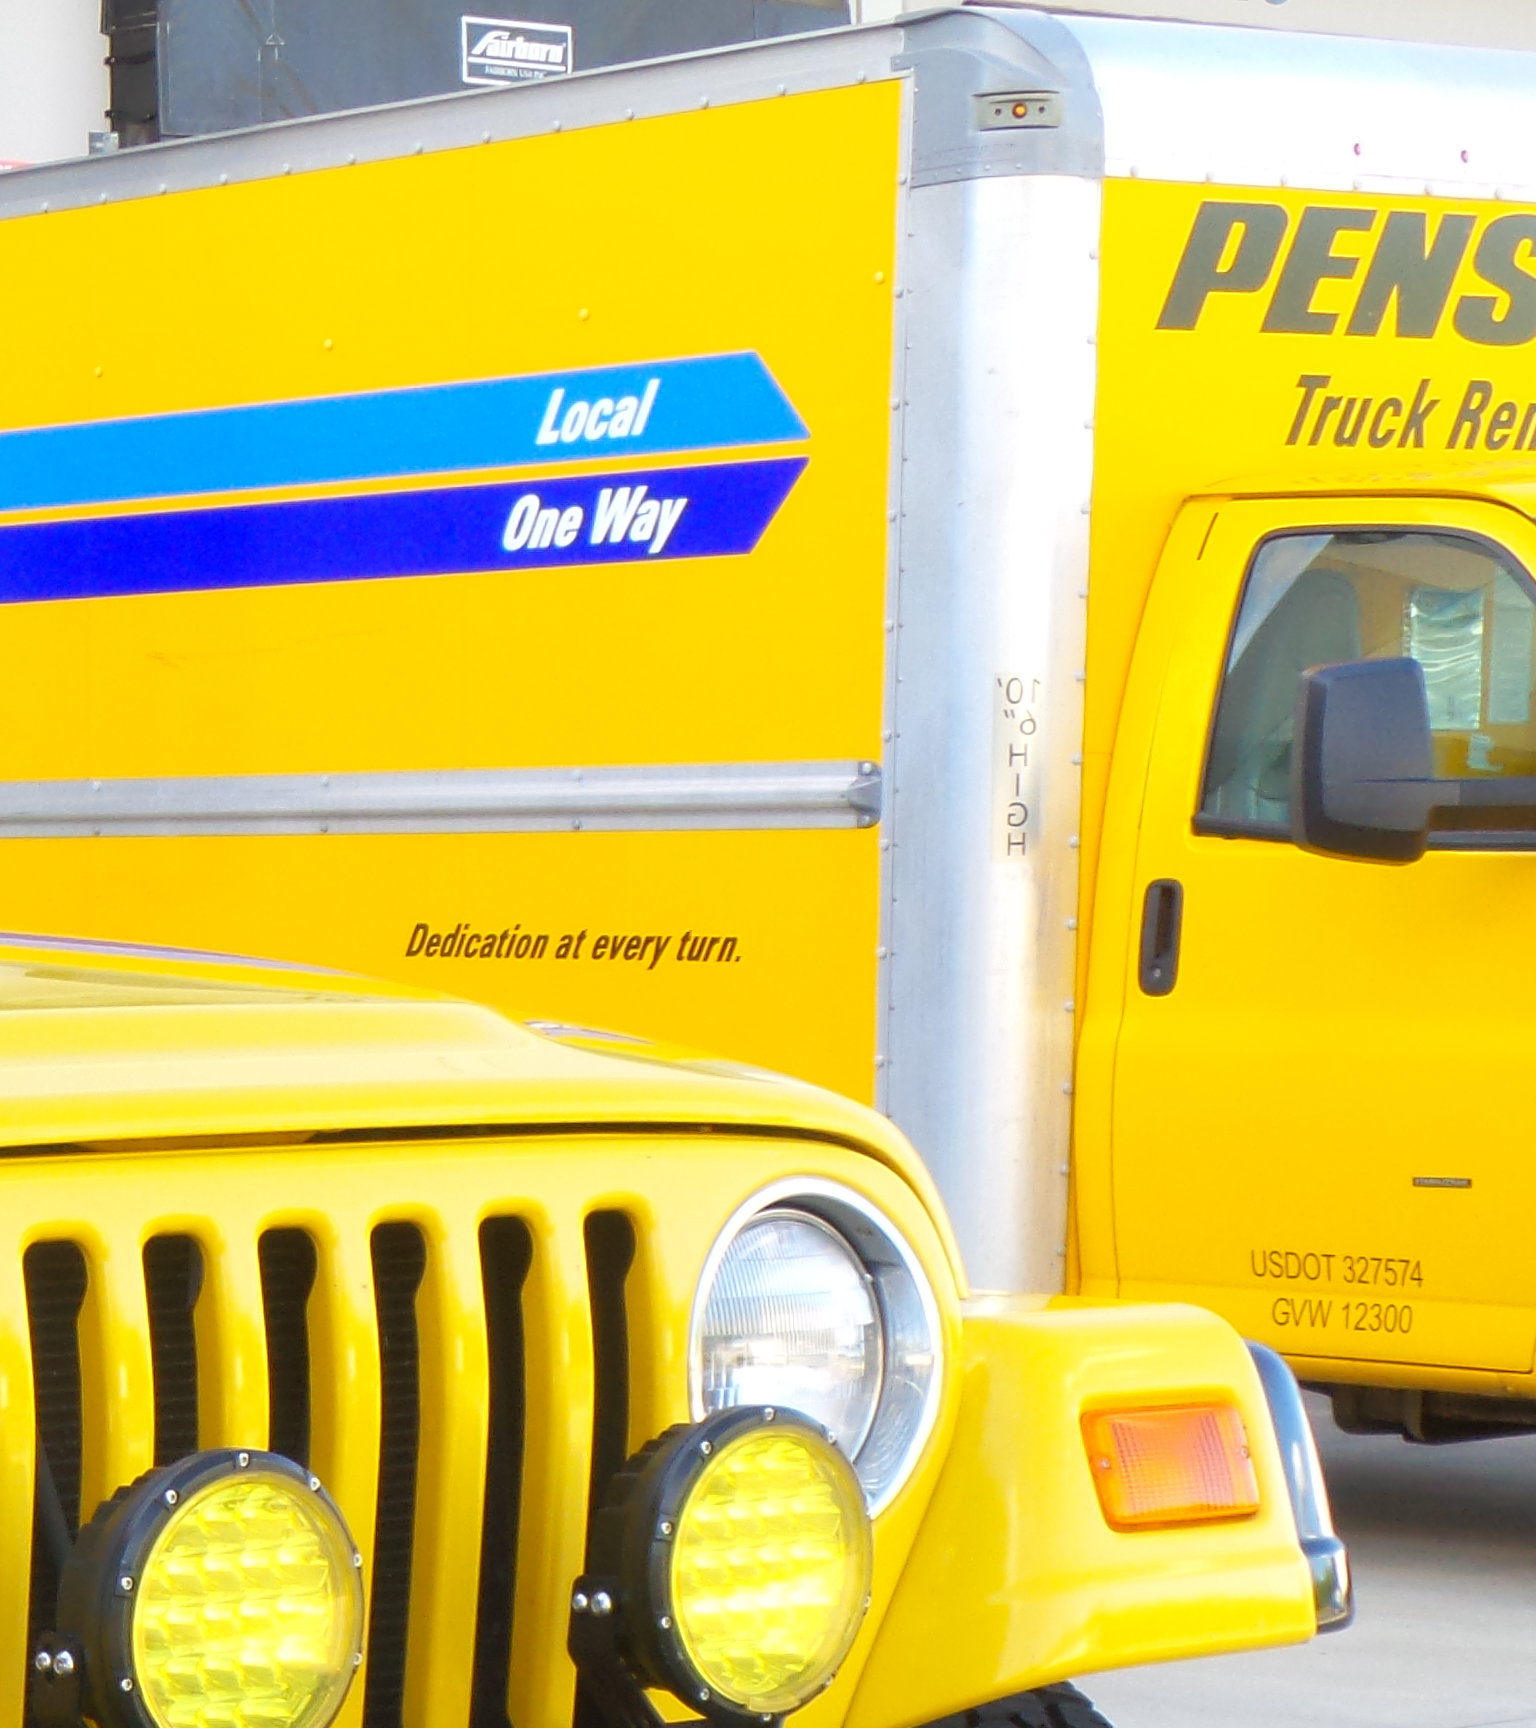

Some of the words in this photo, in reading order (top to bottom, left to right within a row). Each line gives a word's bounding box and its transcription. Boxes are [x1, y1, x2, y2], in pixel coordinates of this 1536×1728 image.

[535, 378, 661, 445] Local
[1285, 374, 1441, 449] Truck
[503, 494, 584, 552] One
[590, 485, 688, 554] Way
[405, 923, 549, 959] Dedication
[555, 929, 588, 960] at
[591, 933, 672, 970] every
[676, 930, 742, 962] turn.
[1251, 1249, 1335, 1281] USDOT
[1343, 1255, 1423, 1288] 327574
[1272, 1298, 1332, 1328] GVW
[1342, 1302, 1413, 1334] 12300
